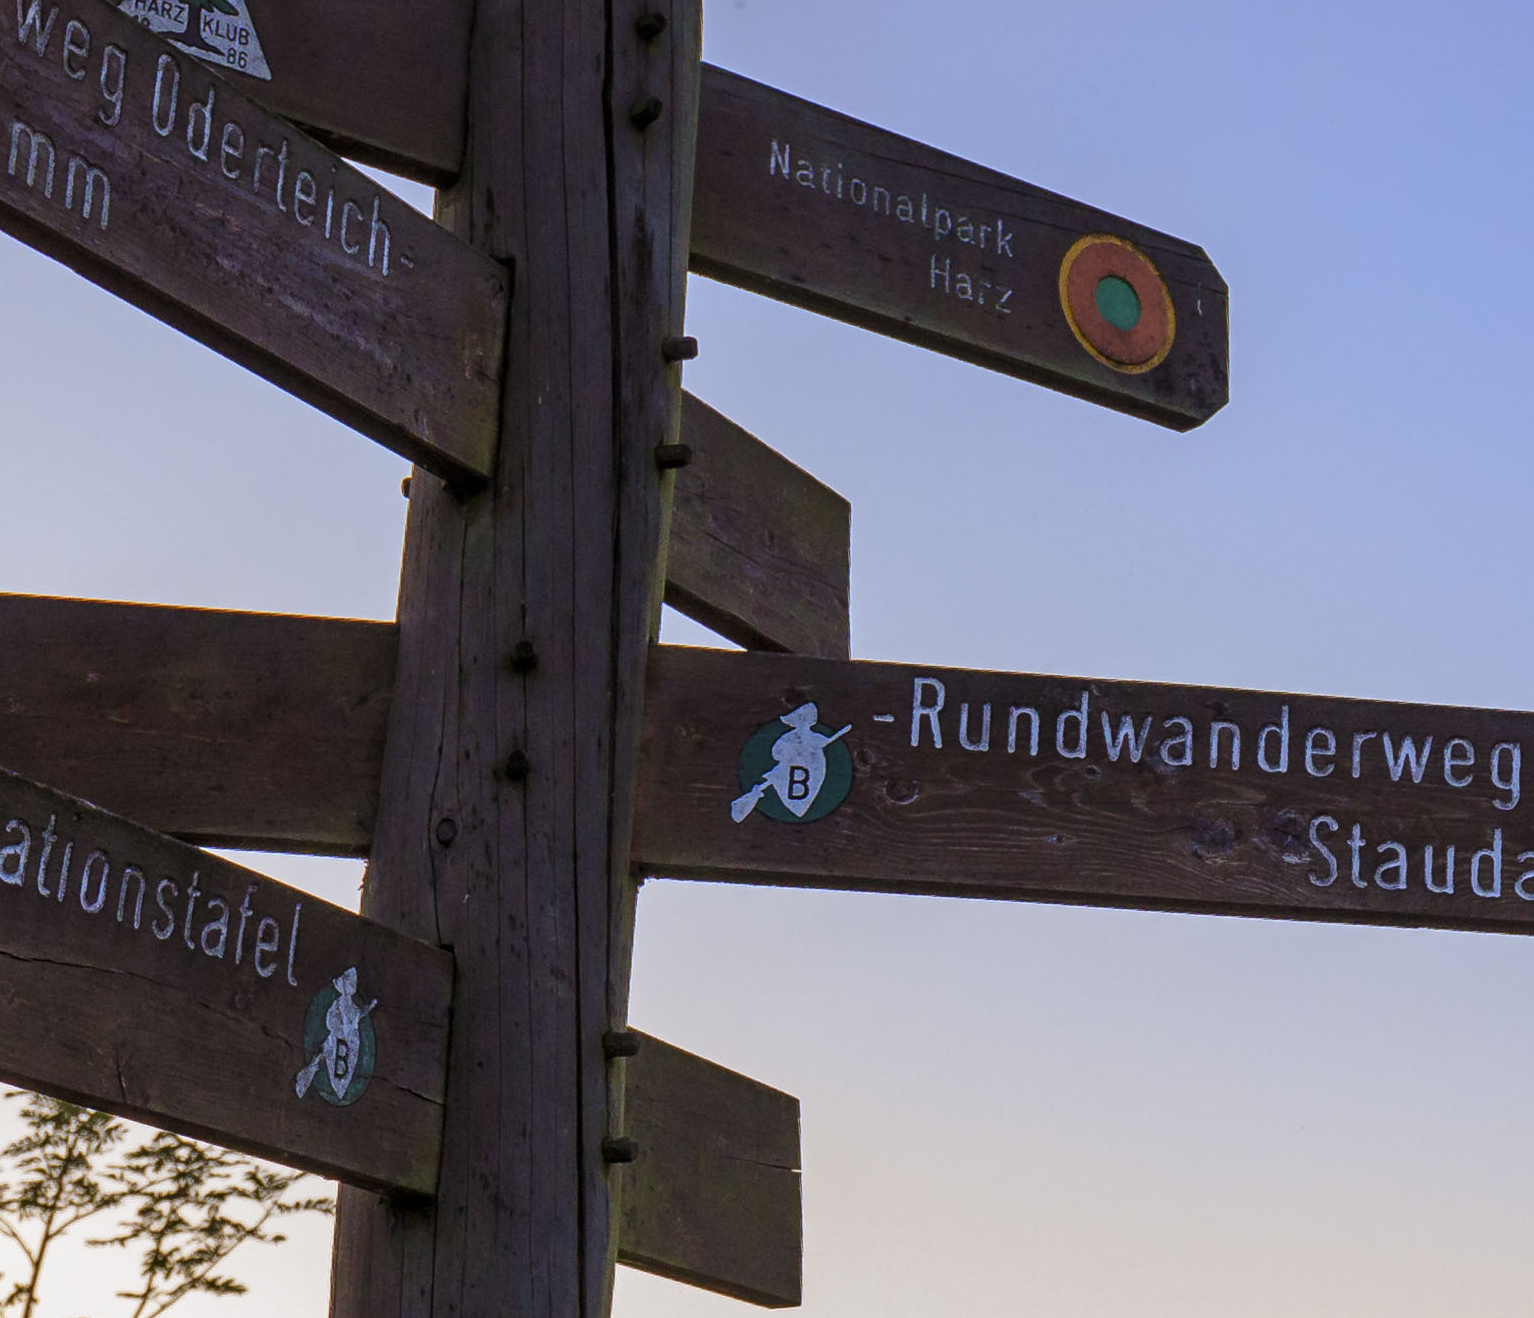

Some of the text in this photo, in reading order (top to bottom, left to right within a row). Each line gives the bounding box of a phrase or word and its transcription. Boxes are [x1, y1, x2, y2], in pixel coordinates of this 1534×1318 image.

[203, 15, 250, 46] KLUB
[226, 47, 248, 69] 86
[769, 138, 1013, 258] Nationalpark
[930, 254, 1013, 314] Harz
[788, 765, 810, 802] B
[333, 1038, 351, 1079] B
